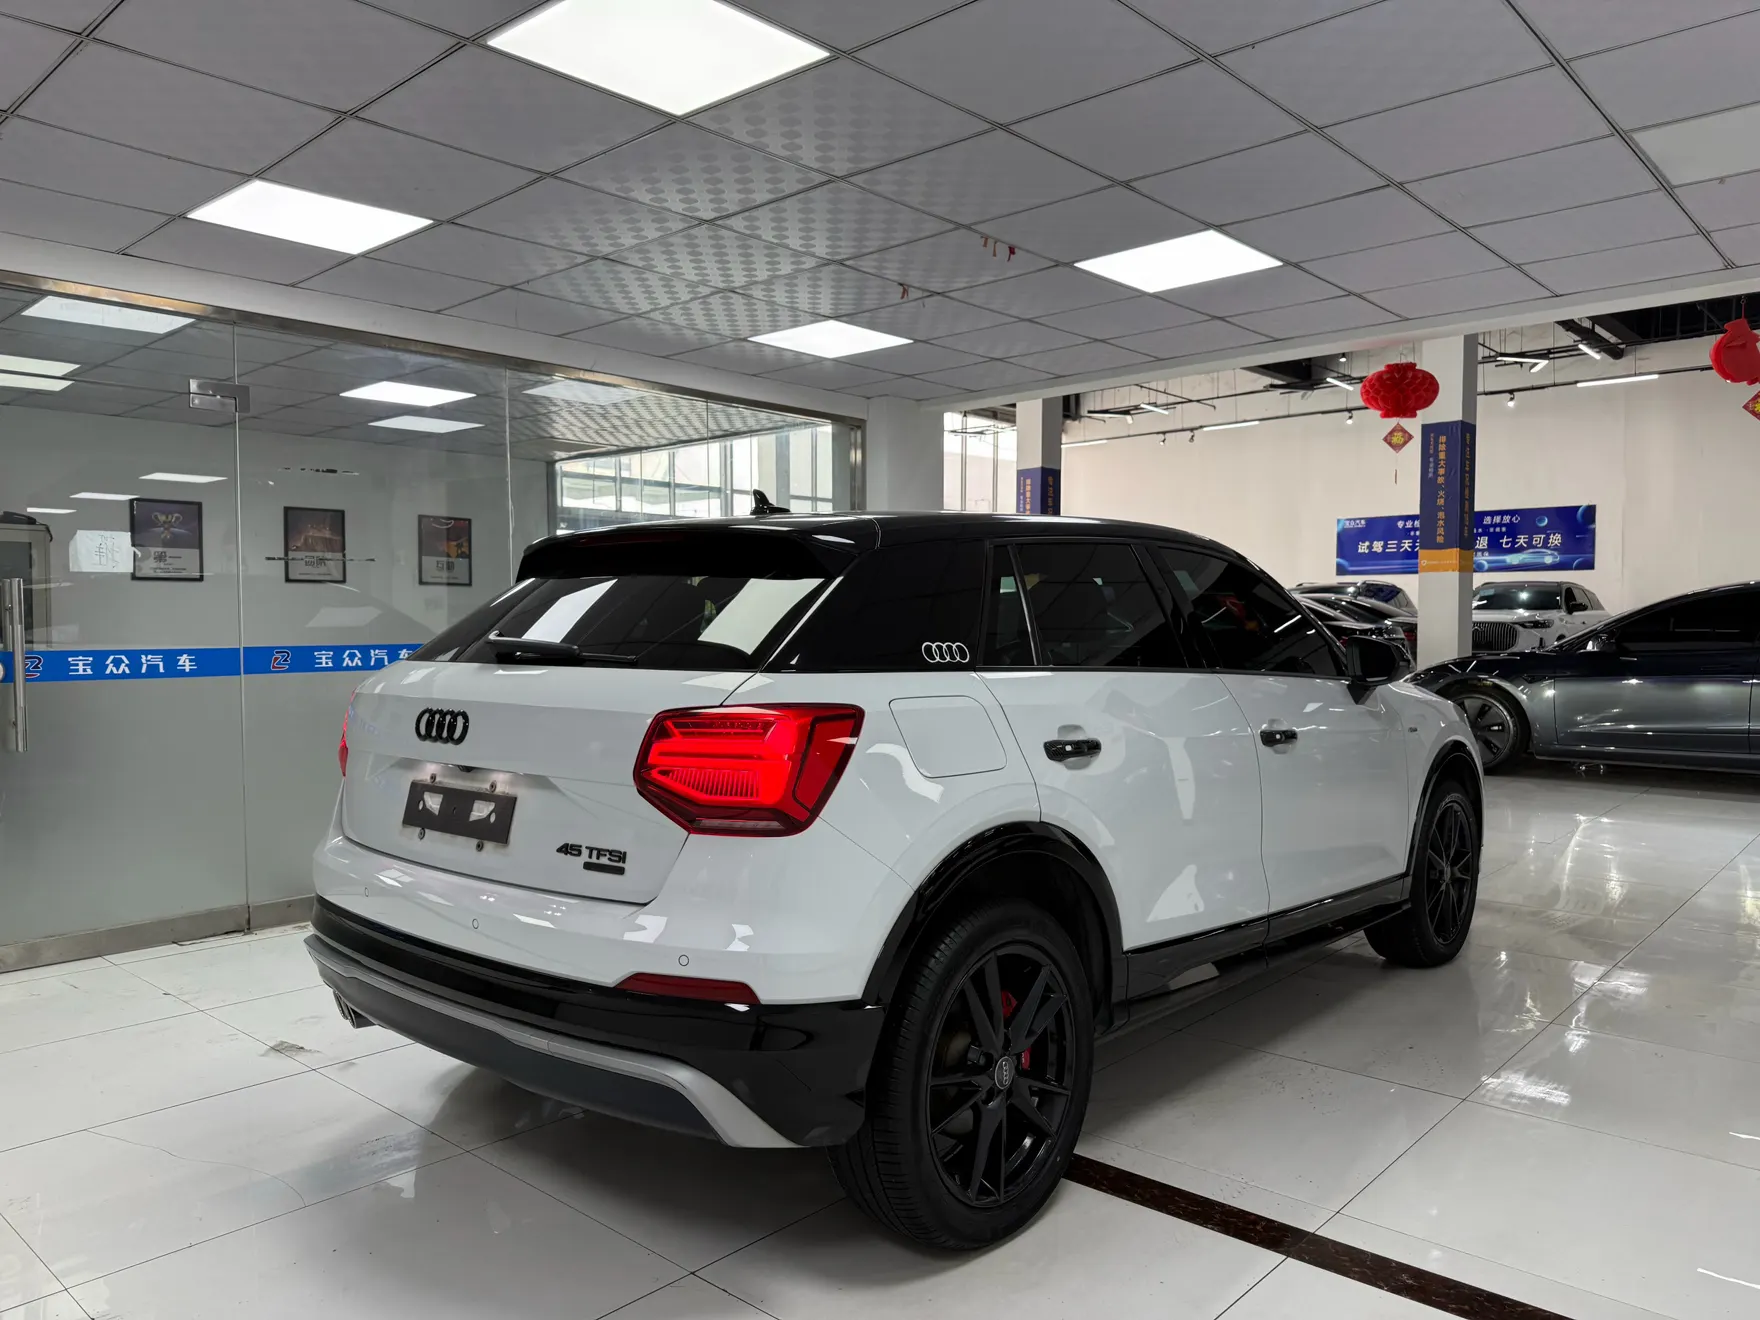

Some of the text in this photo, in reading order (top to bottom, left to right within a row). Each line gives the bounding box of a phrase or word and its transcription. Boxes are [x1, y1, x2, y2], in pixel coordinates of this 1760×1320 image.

[1483, 515, 1520, 525] 选择放心
[1500, 533, 1562, 548] 七天可换
[68, 654, 197, 675] 宝众汽车
[556, 842, 627, 864] 45 TFSI
